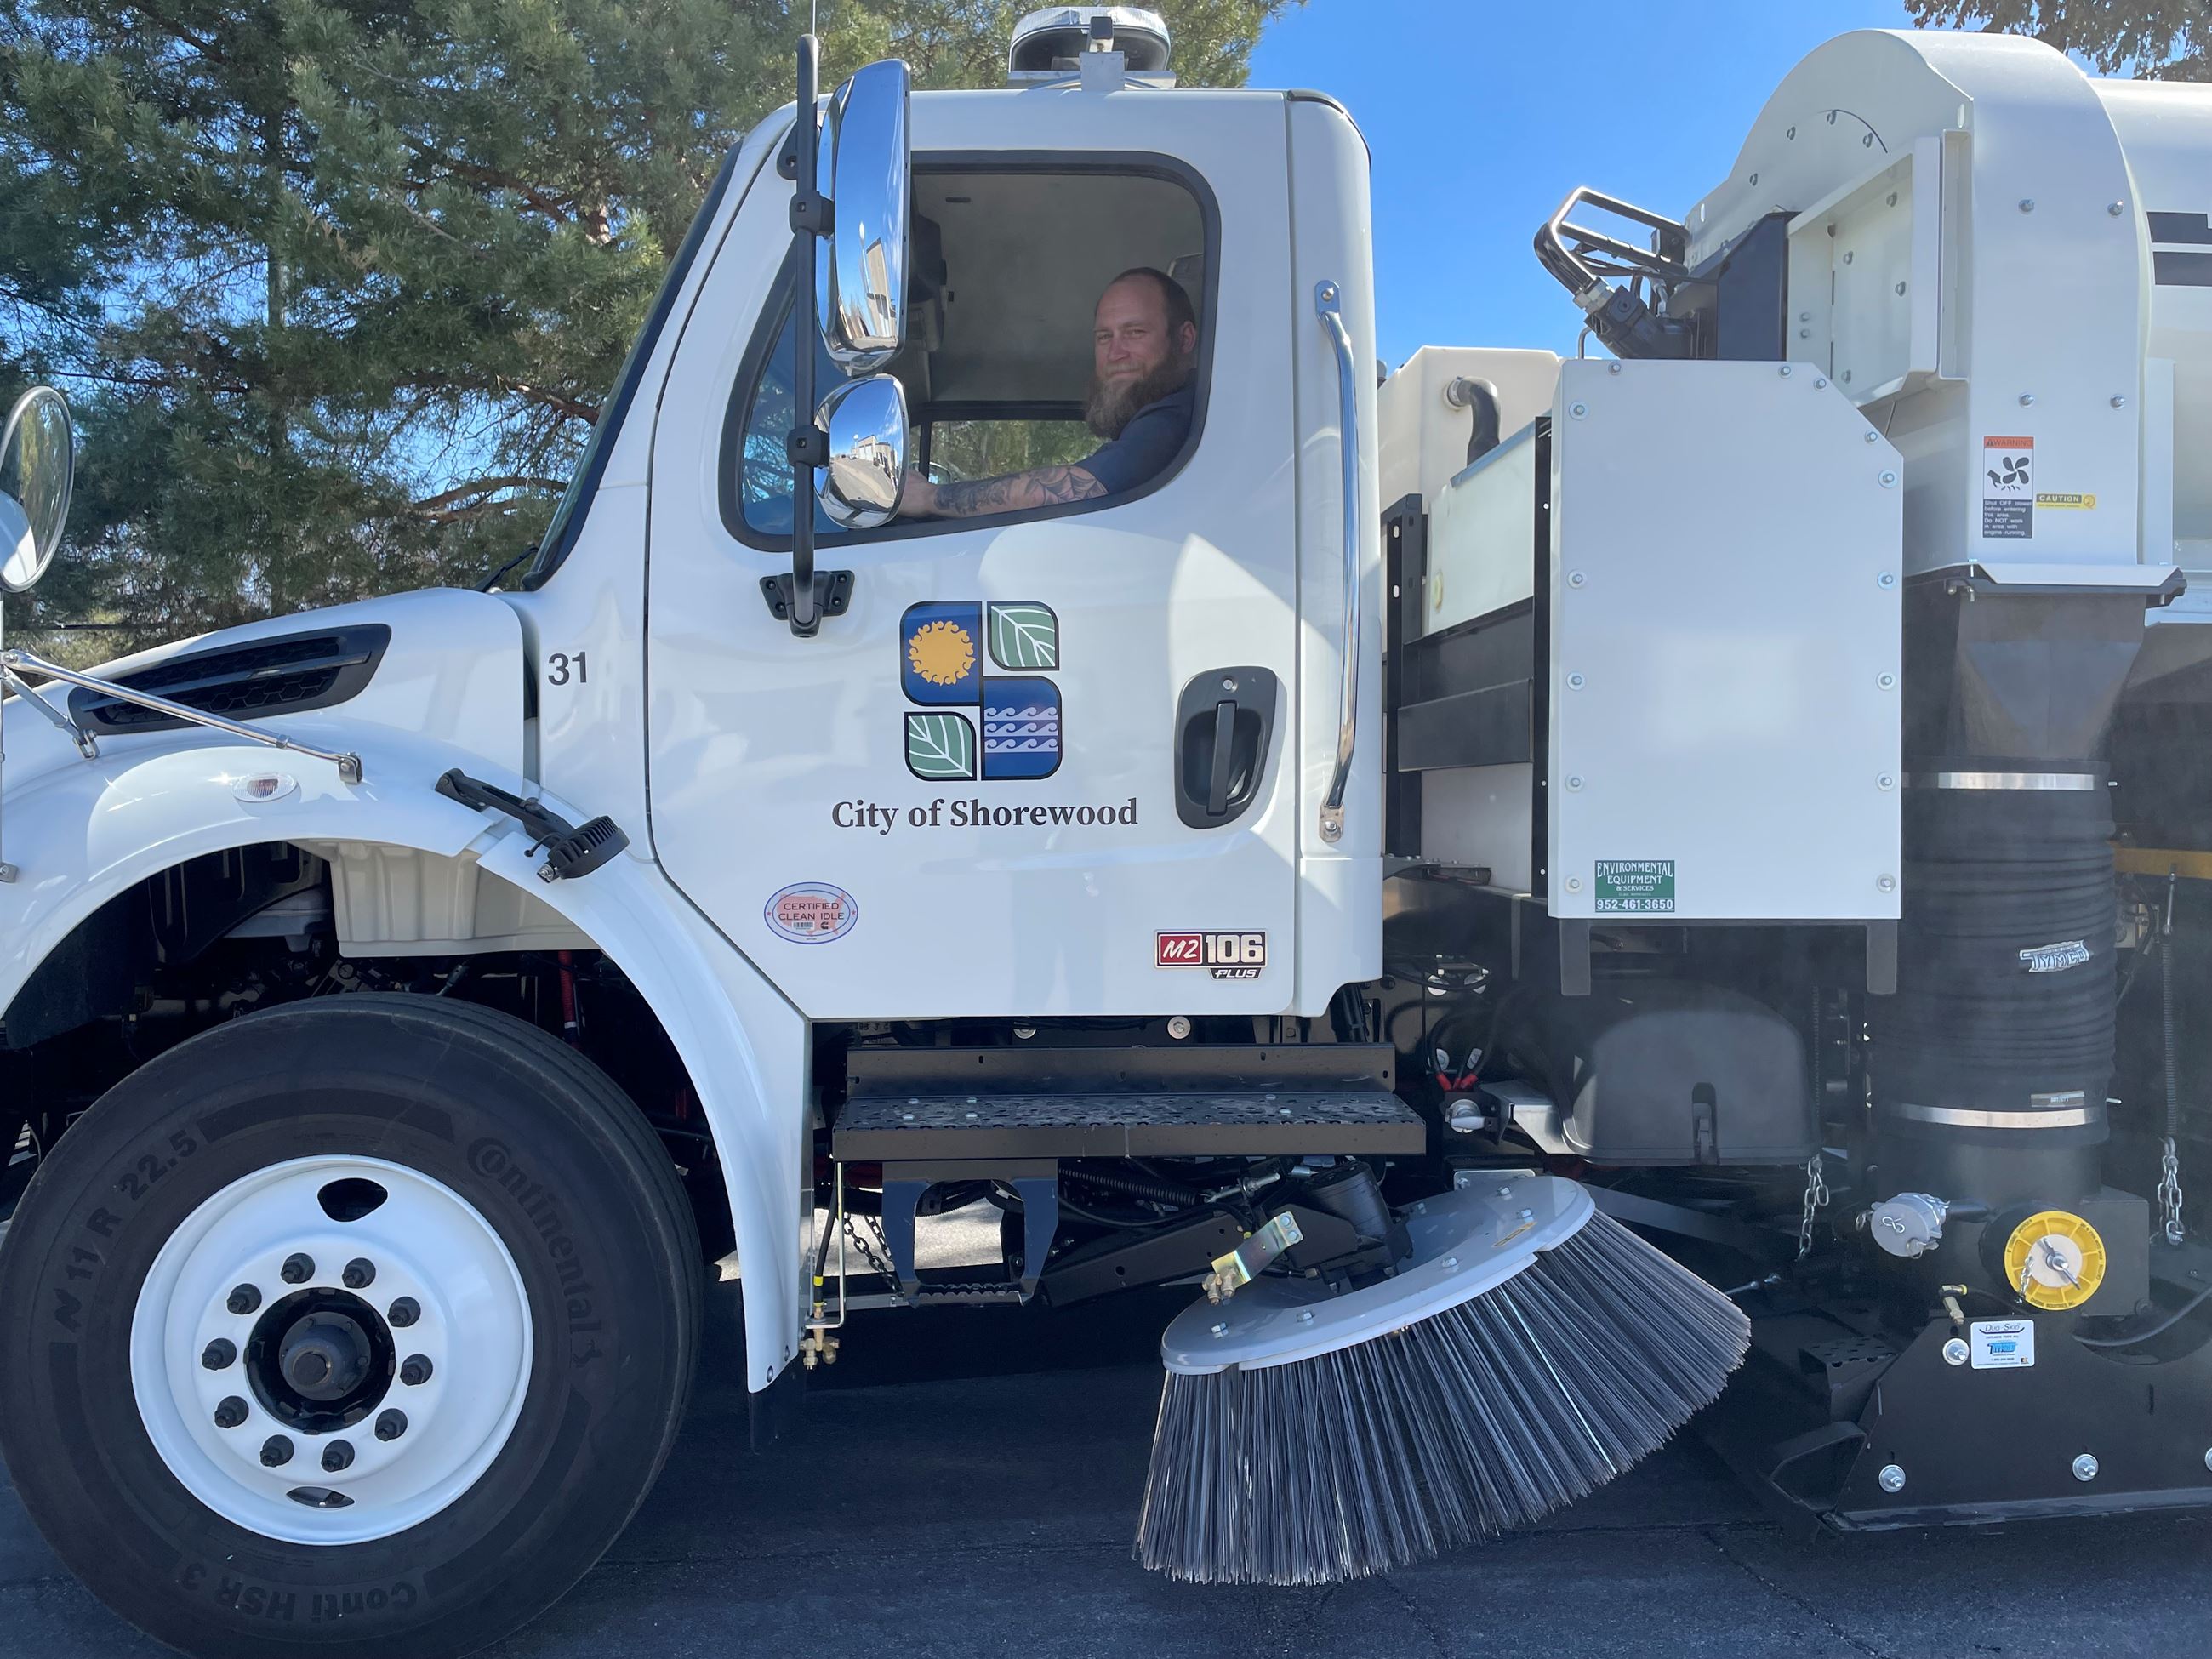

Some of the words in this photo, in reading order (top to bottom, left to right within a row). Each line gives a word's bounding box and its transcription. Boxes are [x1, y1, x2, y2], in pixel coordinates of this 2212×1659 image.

[1993, 438, 2032, 448] WARNING
[548, 651, 587, 686] 31
[832, 799, 899, 835] City
[908, 798, 945, 827] of
[949, 797, 1138, 827] Shorewood
[1597, 862, 1673, 878] ENVIRONMENTAL
[1607, 875, 1663, 885] EQUIPMENT
[784, 902, 840, 911] CERTIFIED
[1596, 899, 1673, 909] 952-461-3650
[1162, 939, 1199, 959] M2
[1205, 934, 1263, 963] 106
[2021, 942, 2087, 971] TYMCO
[1214, 969, 1257, 978] PLUS
[65, 1246, 100, 1280] 11
[86, 1206, 123, 1238] R
[117, 1129, 197, 1201] 22.5
[466, 1136, 603, 1334] Continental
[182, 1562, 207, 1591] 3
[214, 1575, 297, 1621] HSR
[311, 1580, 417, 1624] Conti
